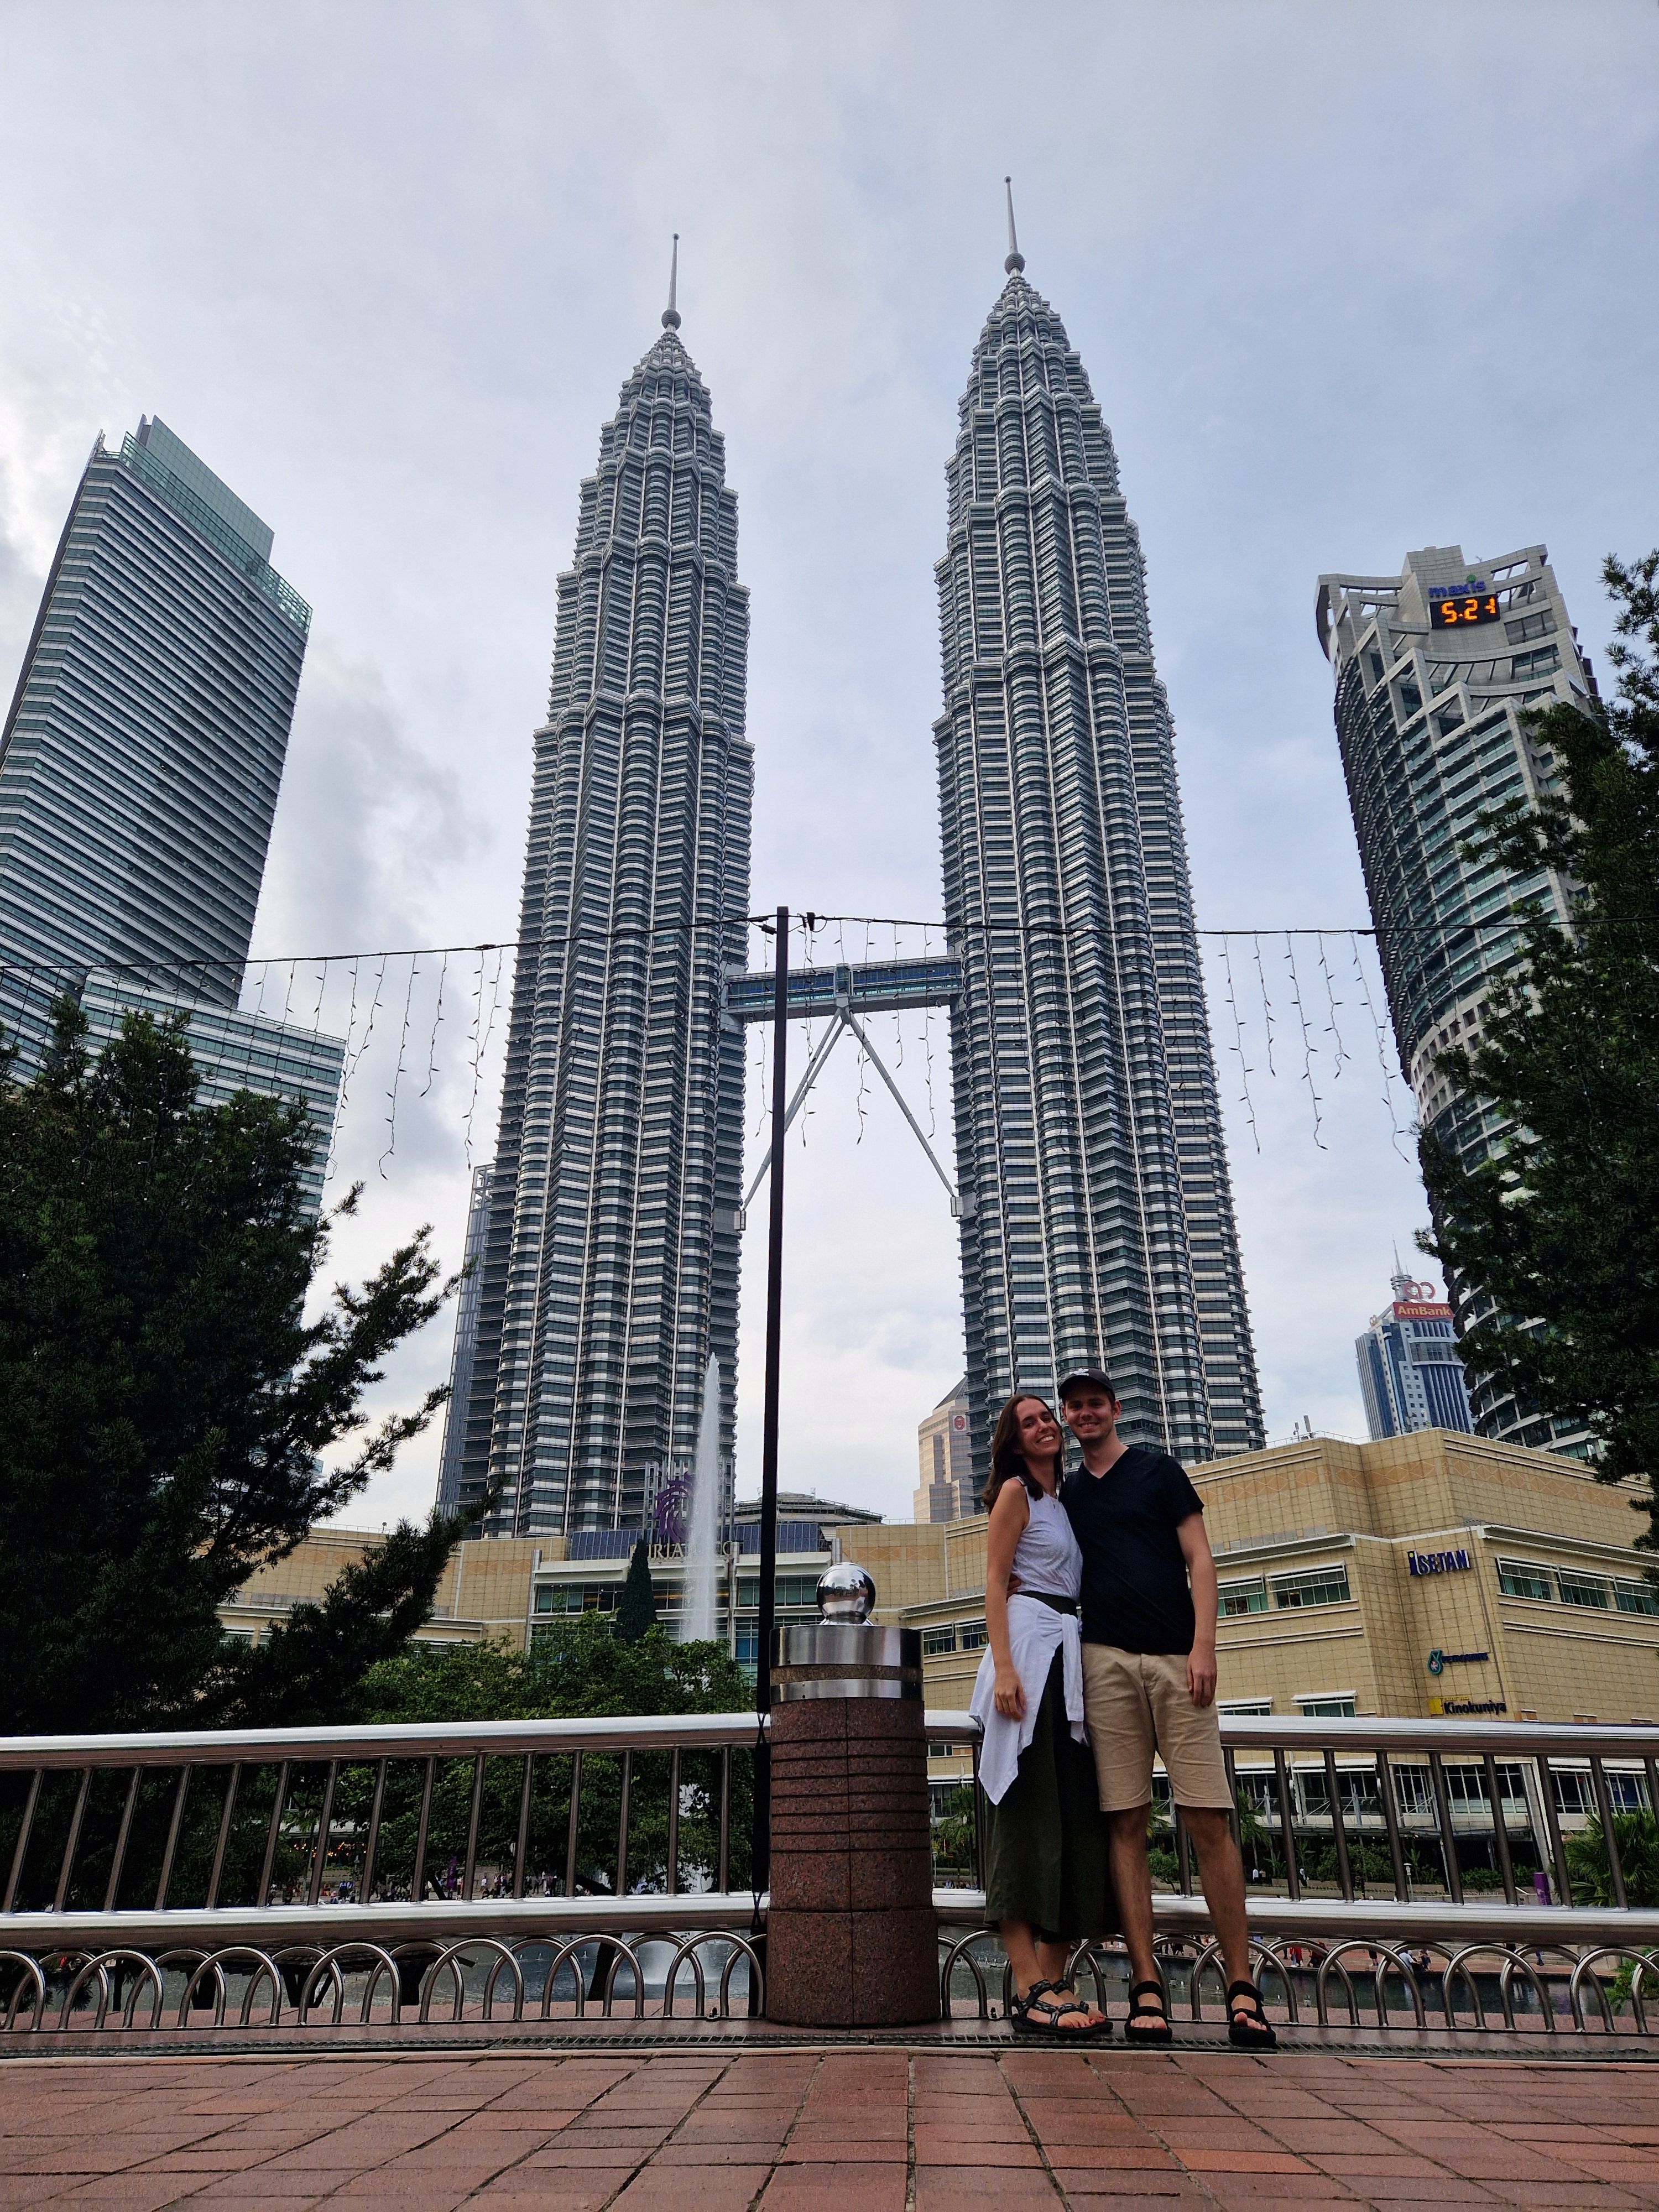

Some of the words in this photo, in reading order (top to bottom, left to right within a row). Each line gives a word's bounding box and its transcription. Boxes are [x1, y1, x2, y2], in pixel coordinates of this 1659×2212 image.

[1428, 575, 1486, 597] maxis
[1398, 1306, 1452, 1316] AmBank
[1443, 1700, 1507, 1715] Kinokuniya
